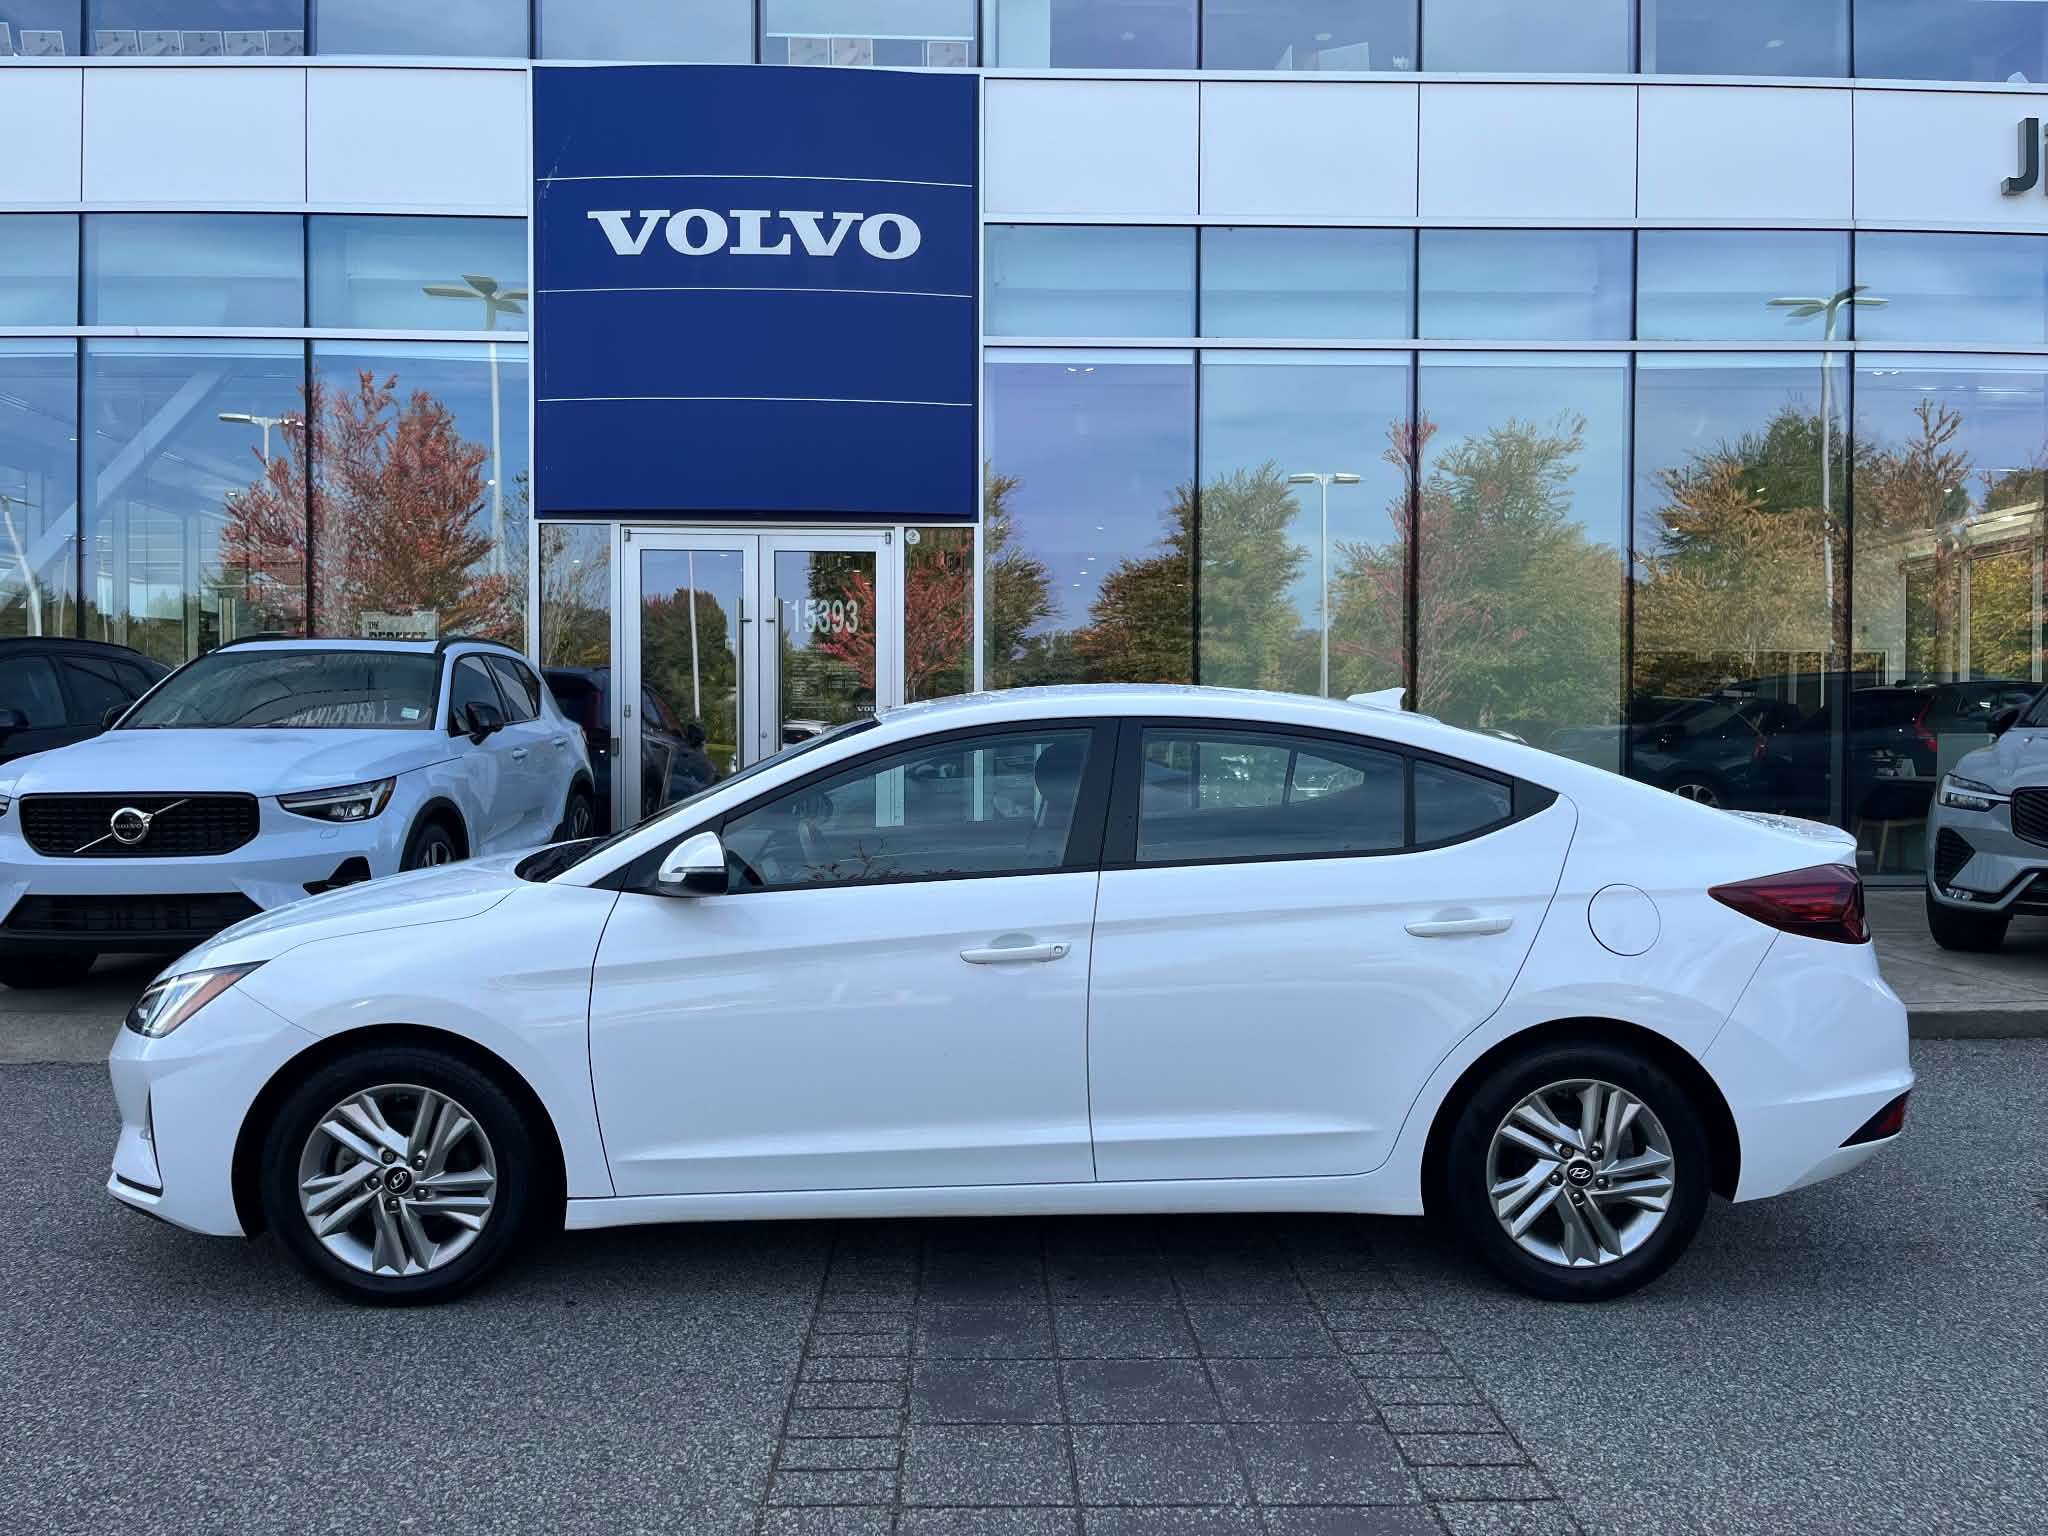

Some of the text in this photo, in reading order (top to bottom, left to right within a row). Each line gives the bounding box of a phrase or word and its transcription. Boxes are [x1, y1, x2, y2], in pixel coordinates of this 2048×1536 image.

[2000, 117, 2048, 196] J
[587, 208, 922, 260] VOLVO
[791, 600, 858, 633] 15393
